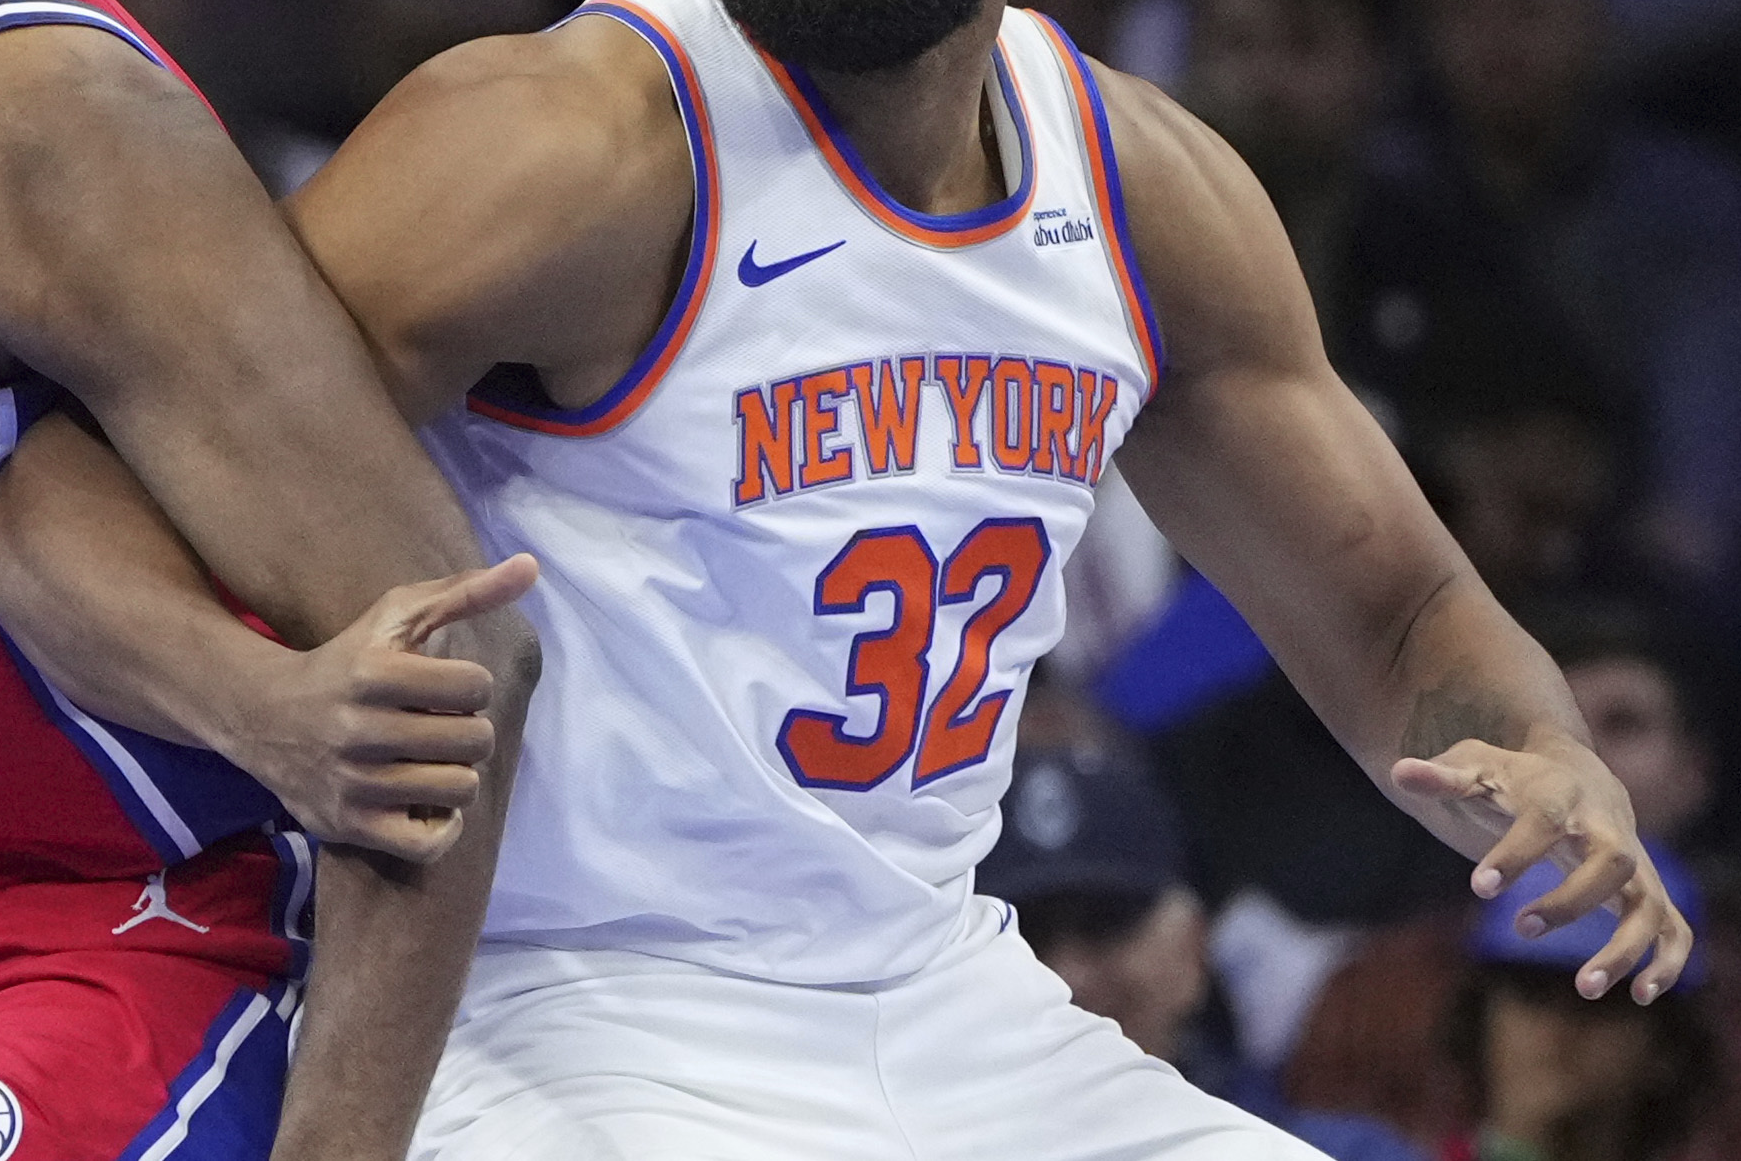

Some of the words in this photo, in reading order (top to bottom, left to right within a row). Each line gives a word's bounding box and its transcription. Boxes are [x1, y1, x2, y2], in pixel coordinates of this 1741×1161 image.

[1033, 223, 1061, 247] abu
[731, 352, 929, 513] NEW
[932, 352, 1119, 489] YORK
[775, 516, 1053, 793] 32
